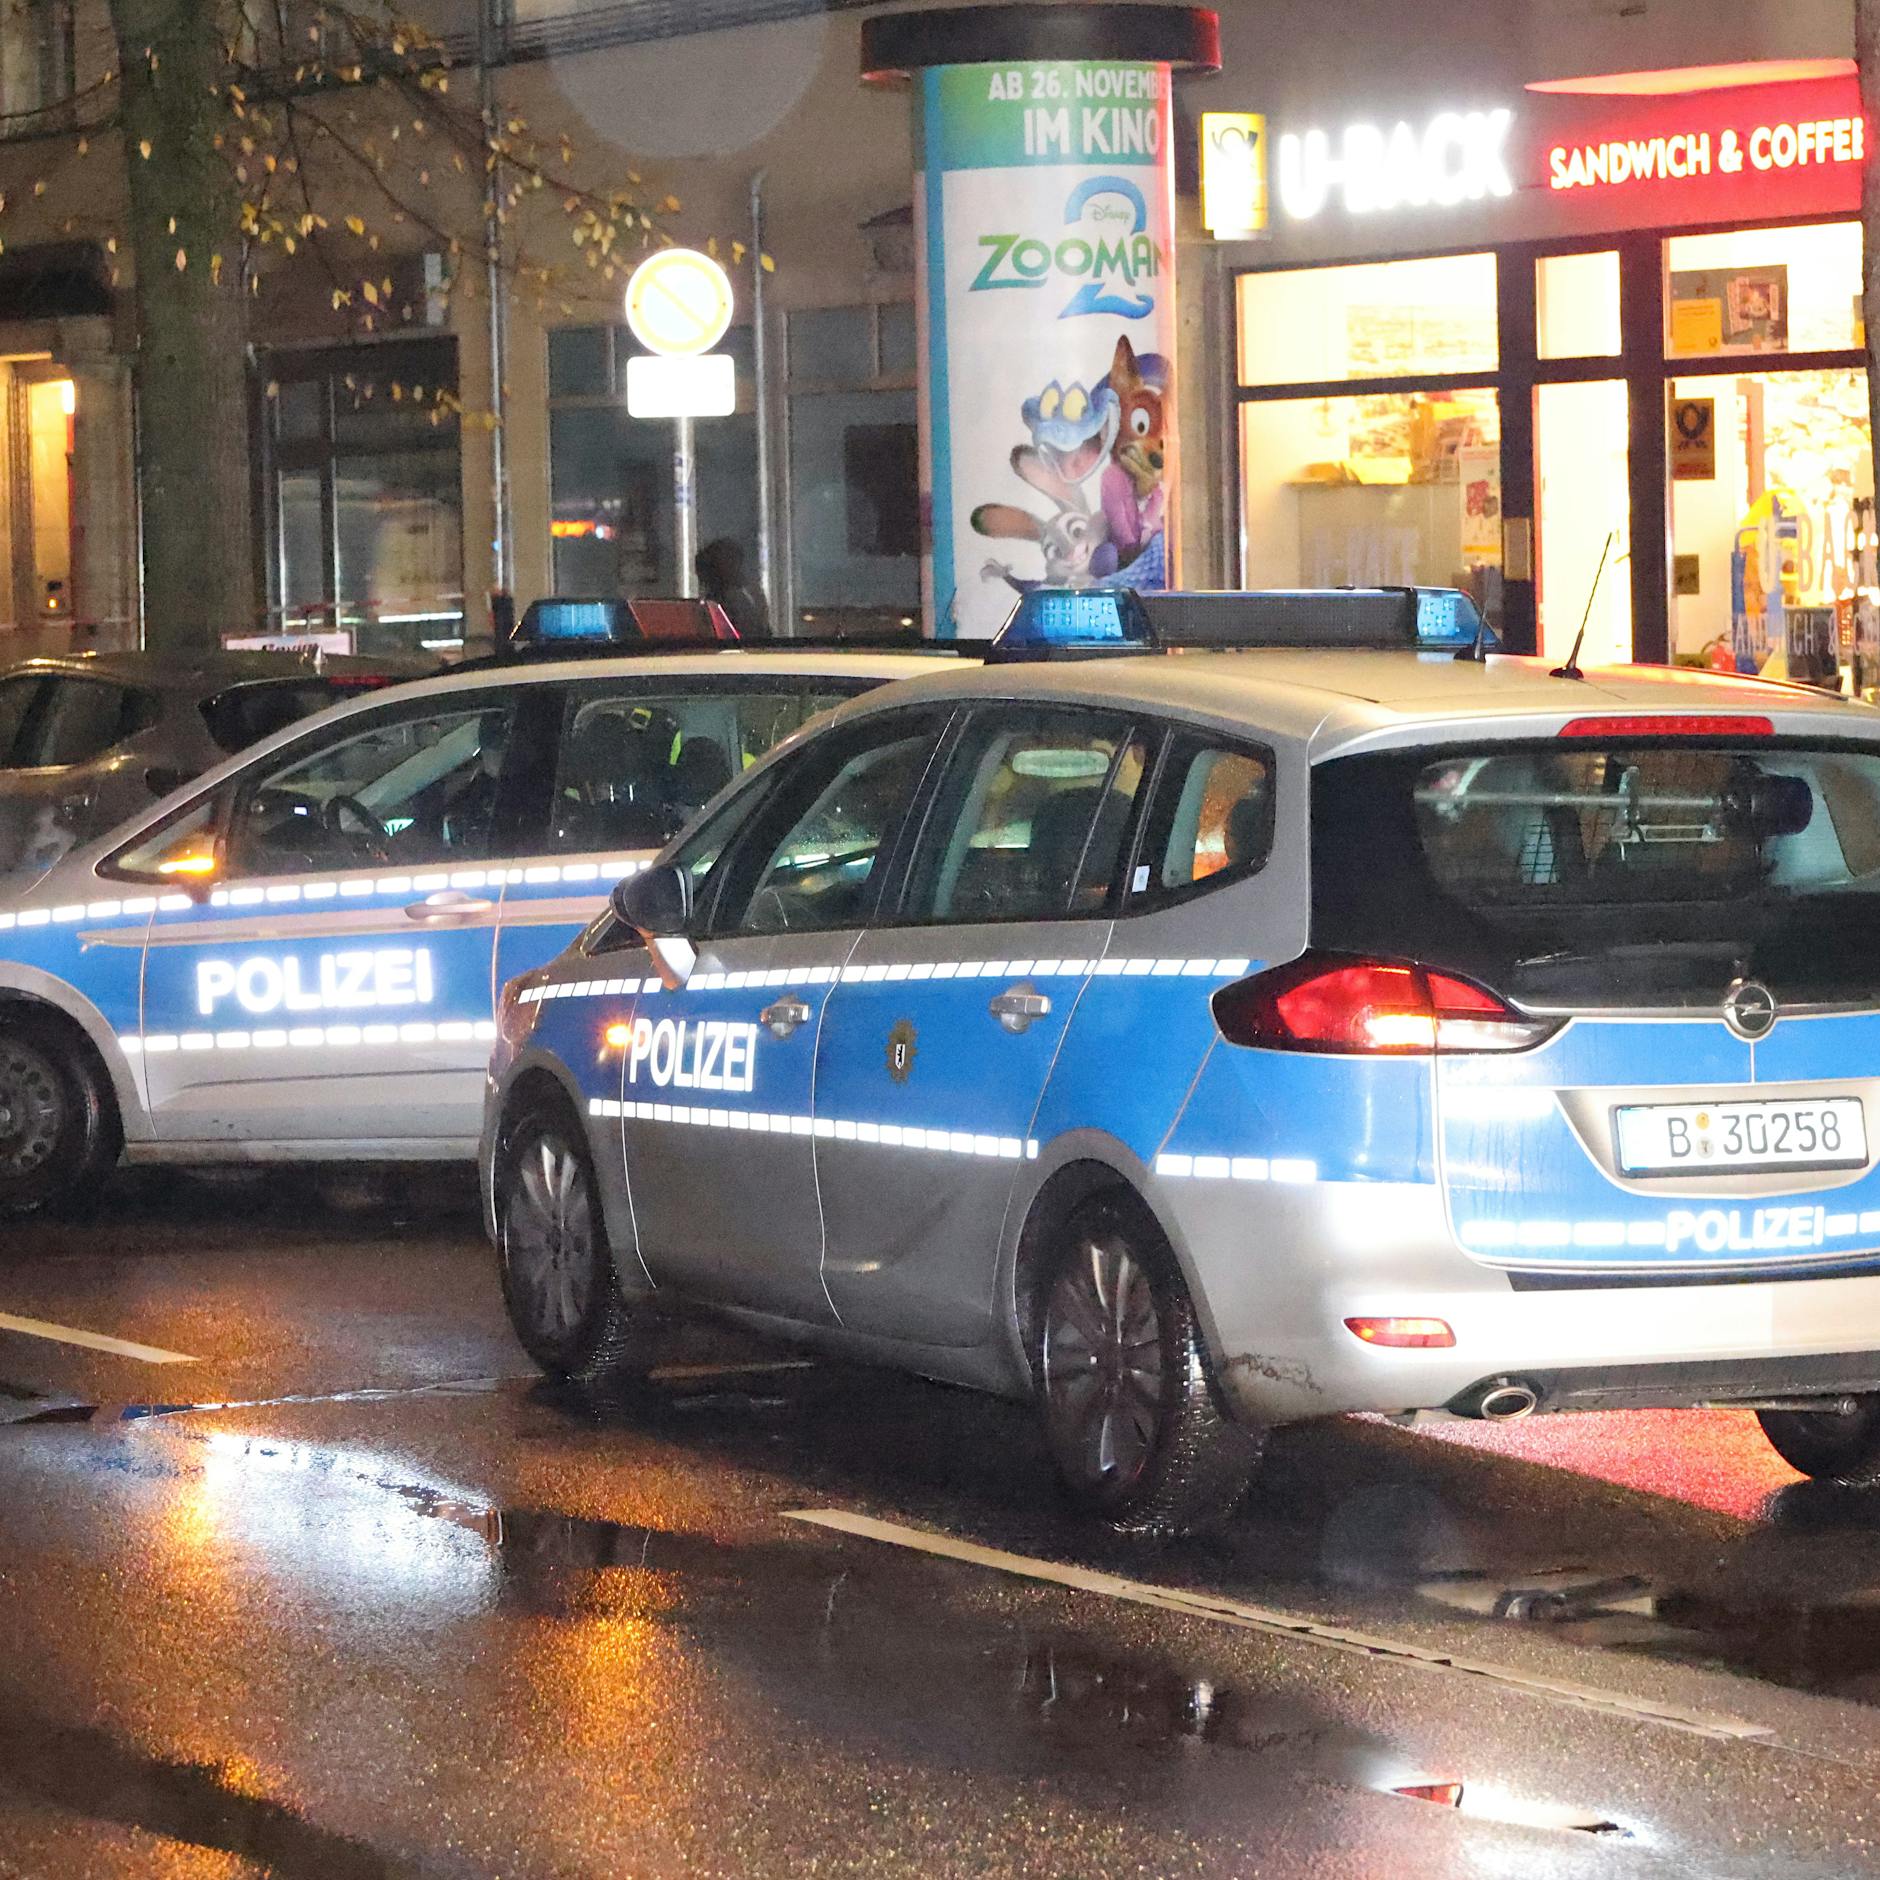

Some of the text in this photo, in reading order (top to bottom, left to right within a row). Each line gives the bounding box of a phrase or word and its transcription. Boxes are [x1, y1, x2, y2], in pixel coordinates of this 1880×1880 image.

[988, 71, 1024, 100] AB
[1031, 69, 1068, 99] 26.
[1023, 107, 1161, 155] IM KINO
[1550, 132, 1711, 190] SANDWICH
[1718, 128, 1743, 174] &
[197, 947, 434, 1016] POLIZEI
[629, 1018, 757, 1092] POLIZEI
[1667, 1110, 1841, 1158] B 30258
[1665, 1206, 1826, 1253] POLIZEI
